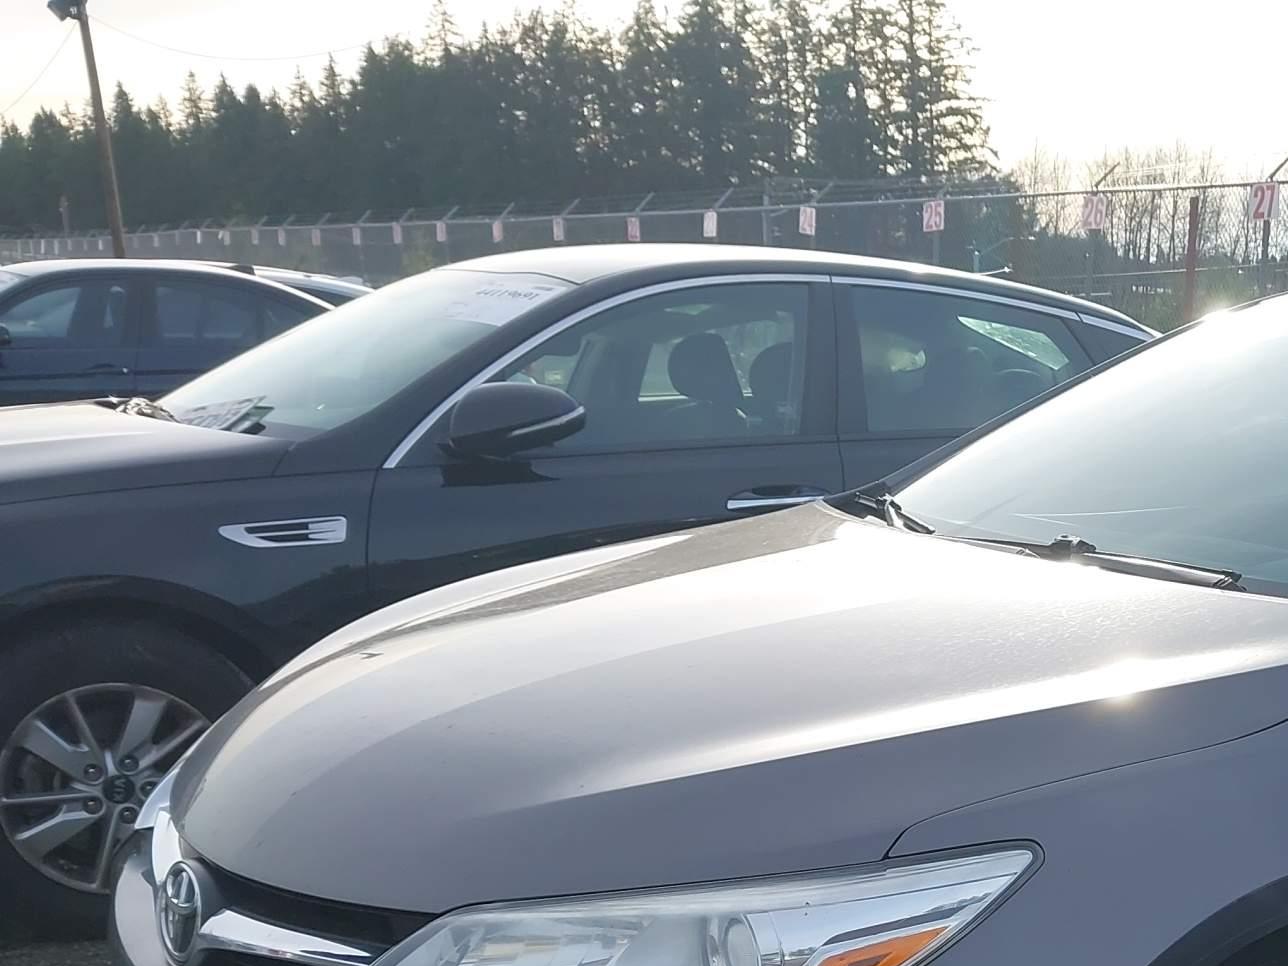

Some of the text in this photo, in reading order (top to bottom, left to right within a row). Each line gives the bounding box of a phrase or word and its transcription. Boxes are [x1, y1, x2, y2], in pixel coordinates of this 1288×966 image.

[925, 202, 942, 229] 25
[1084, 197, 1104, 227] 26
[1253, 184, 1275, 218] 27
